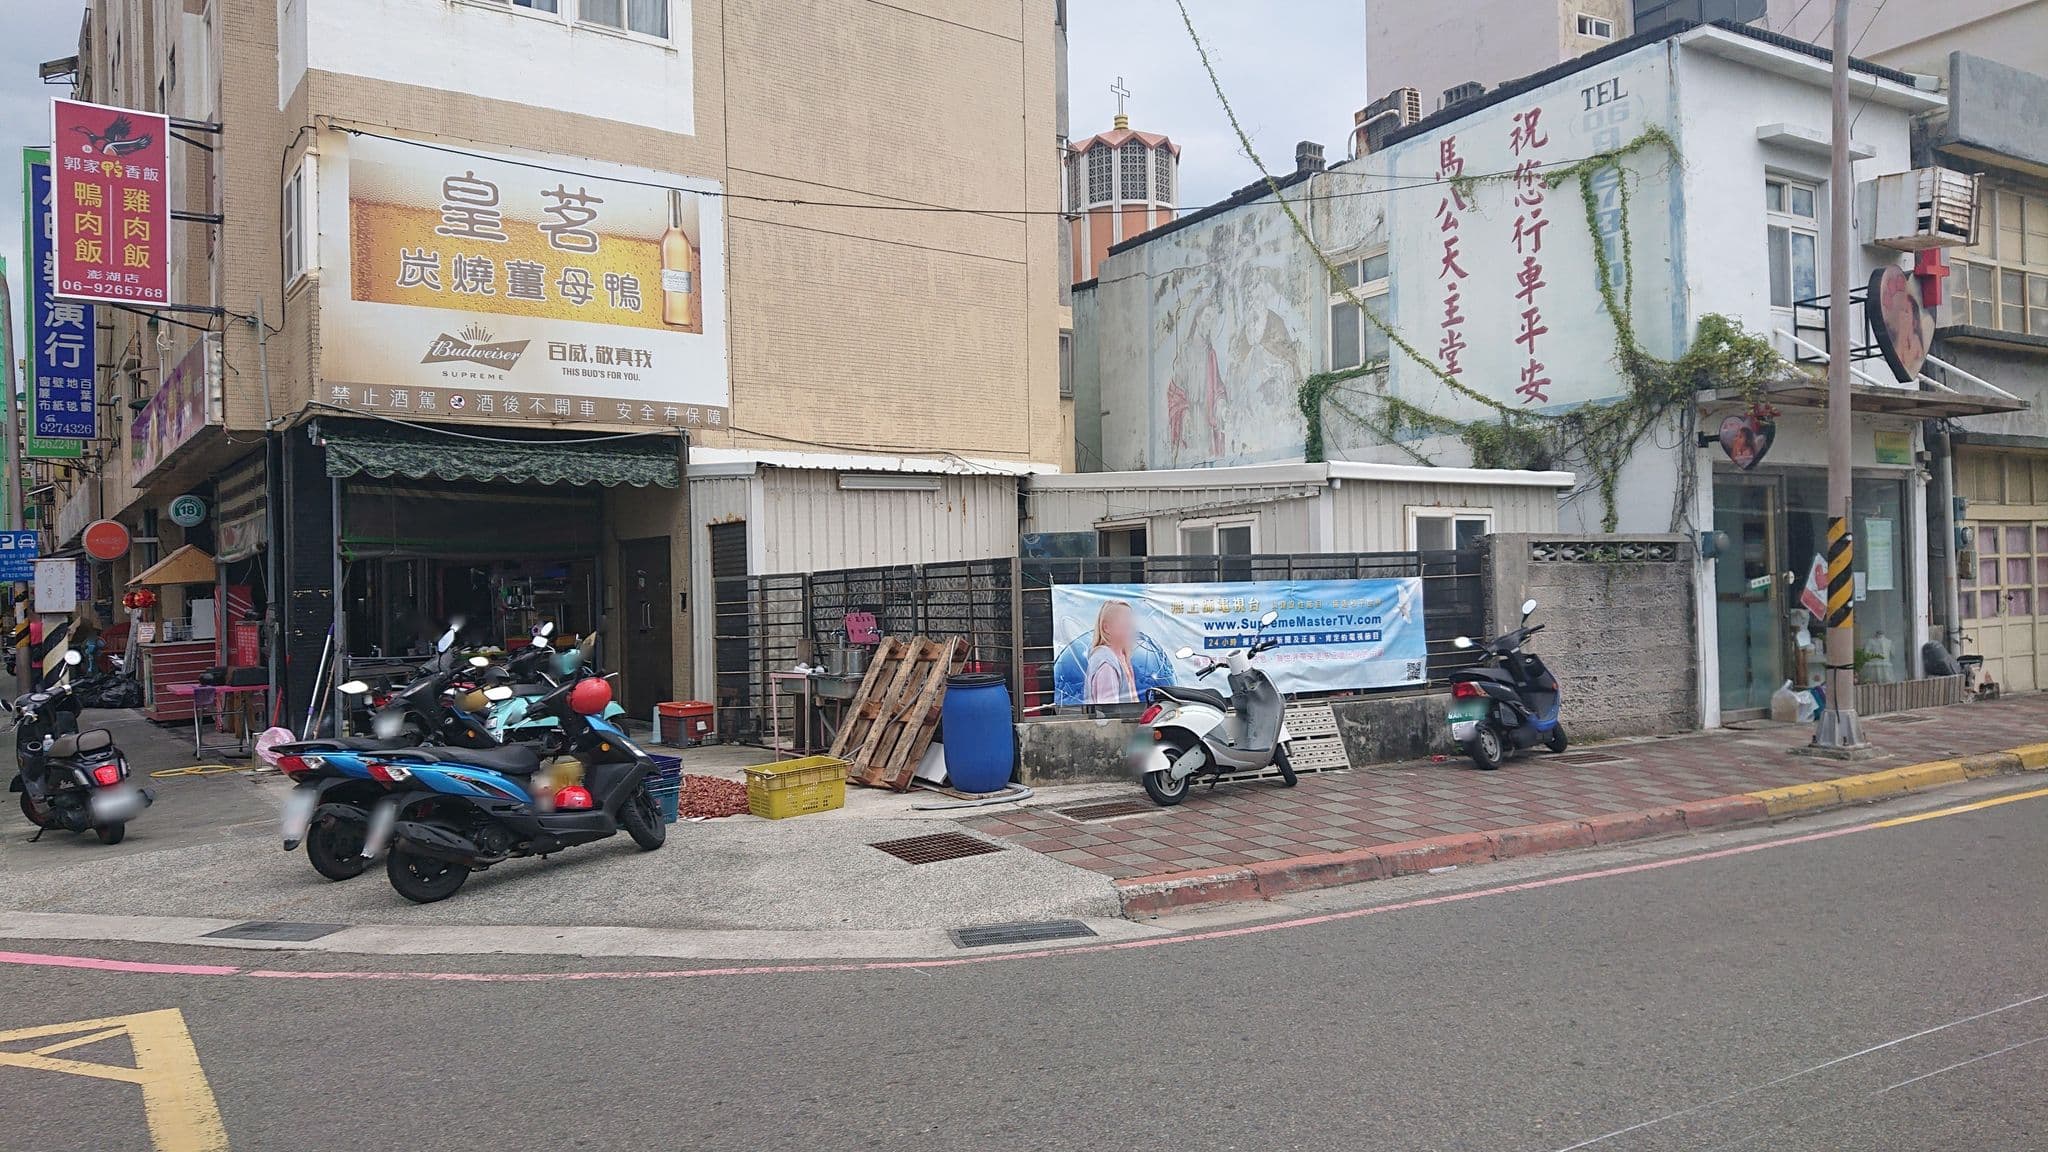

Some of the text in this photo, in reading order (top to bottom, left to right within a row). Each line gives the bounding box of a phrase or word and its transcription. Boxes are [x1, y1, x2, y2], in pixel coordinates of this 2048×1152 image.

[1581, 77, 1629, 111] TEL
[74, 181, 103, 264] 鴨肉飯
[434, 170, 605, 254] 皇茗
[122, 187, 151, 269] 雞肉飯
[1435, 135, 1470, 377] 馬公天主堂
[1509, 107, 1551, 404] 祝您行車平安
[62, 280, 163, 298] 06-9265768
[87, 269, 140, 284] 澎湖店
[396, 247, 643, 313] 炭燒薑母鴨
[429, 339, 523, 362] Budweiser
[442, 370, 505, 381] SUPREME
[562, 367, 641, 382] THIS BUD'S FOR YOU.
[331, 385, 722, 426] 禁止酒駕 酒後不開車 安全有保障
[40, 422, 93, 435] 9274326
[180, 505, 196, 515] 18
[1208, 638, 1219, 648] 24
